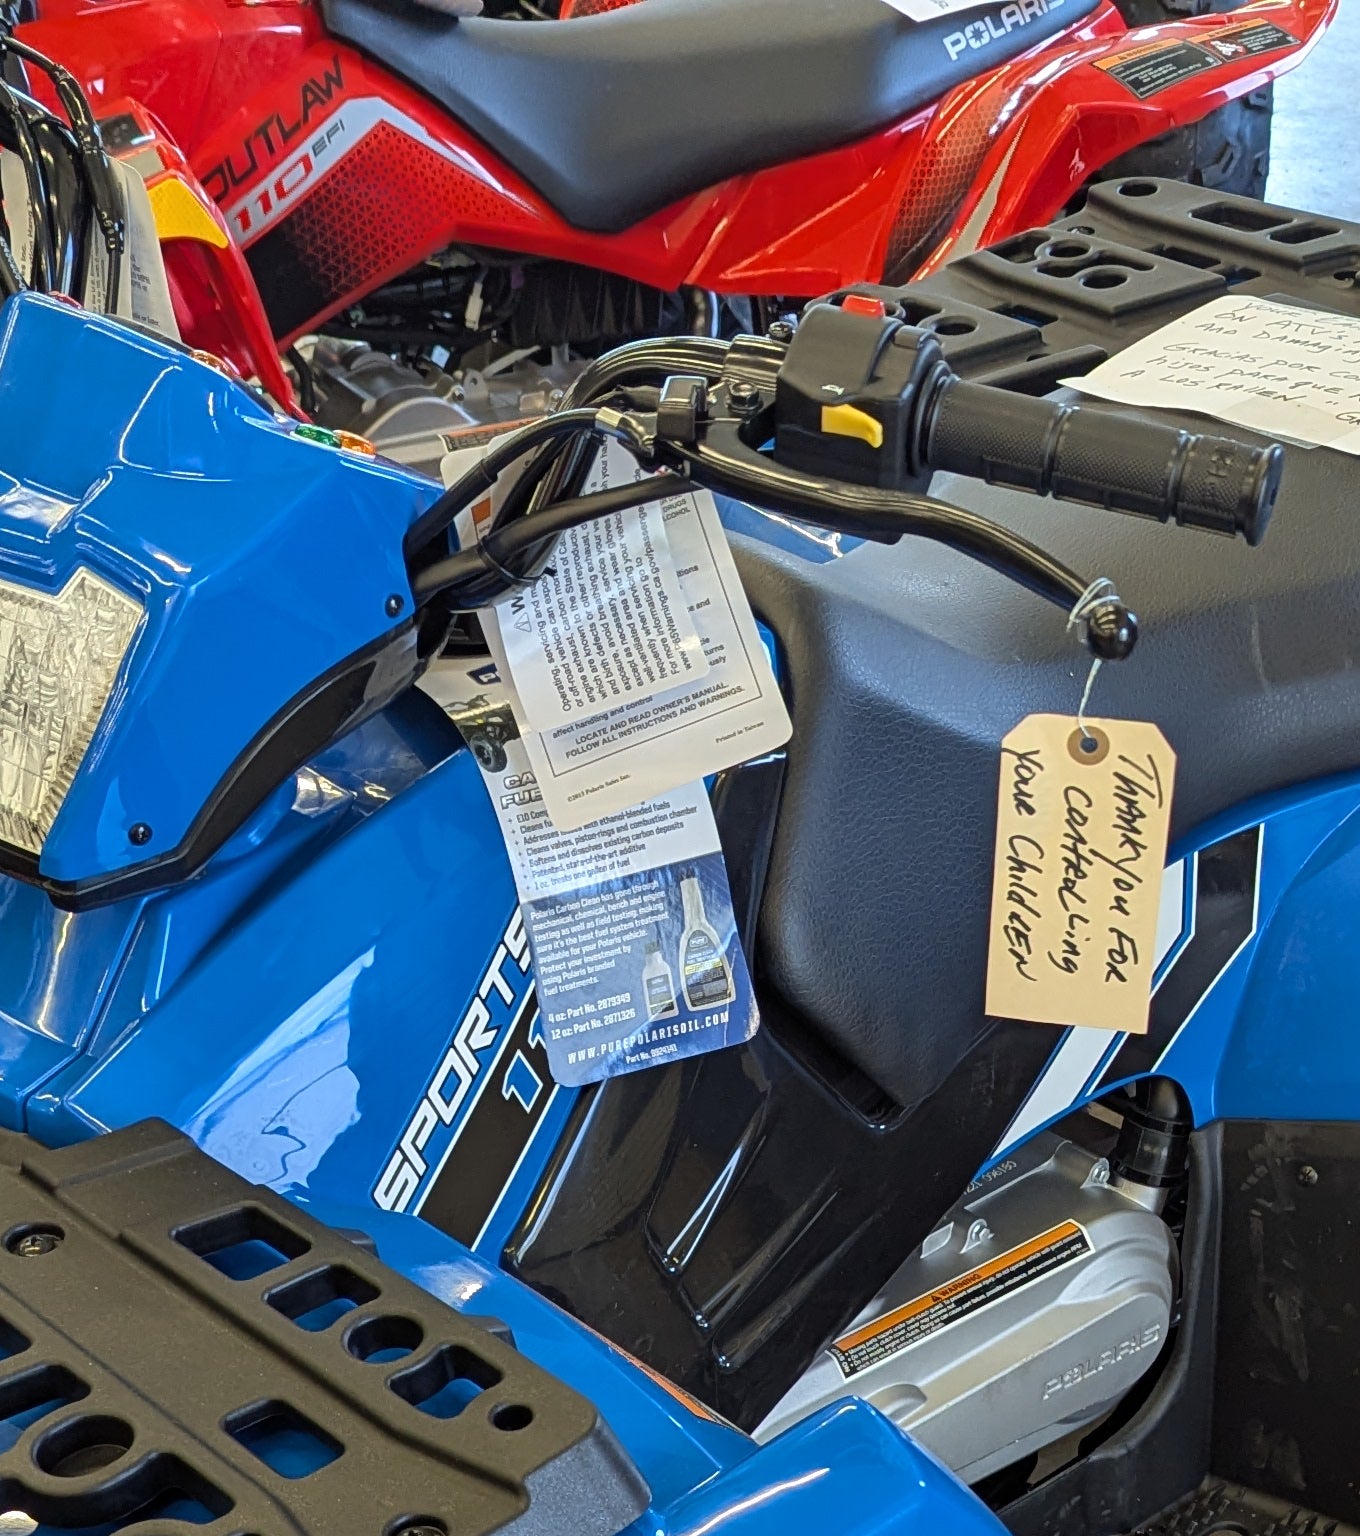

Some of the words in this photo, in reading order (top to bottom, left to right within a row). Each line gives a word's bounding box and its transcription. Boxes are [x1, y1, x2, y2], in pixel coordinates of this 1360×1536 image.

[200, 54, 344, 204] OUTLAW
[236, 153, 314, 232] 110
[311, 118, 345, 157] EFI
[591, 533, 606, 555] your
[598, 517, 619, 549] gloves
[558, 555, 569, 566] of
[576, 531, 600, 572] exhaust,
[606, 550, 621, 575] wear
[617, 542, 632, 564] your
[632, 556, 643, 567] to
[559, 567, 576, 594] State
[594, 557, 614, 592] service
[611, 577, 626, 597] and
[622, 565, 645, 609] servicing
[637, 568, 648, 582] go
[566, 595, 579, 612] the
[575, 582, 592, 608] other
[586, 573, 610, 620] breathing
[529, 599, 543, 619] and
[544, 606, 557, 625] can
[554, 597, 572, 631] carbon
[571, 613, 582, 623] to
[583, 609, 593, 621] or
[619, 598, 633, 621] area
[640, 583, 665, 636] information
[599, 621, 616, 648] avoid
[635, 610, 652, 637] when
[534, 620, 557, 664] servicing
[549, 625, 568, 661] vehicle
[575, 624, 592, 657] known
[587, 621, 605, 657] defects
[622, 646, 632, 658] as
[626, 620, 656, 683] well-ventilated
[659, 636, 674, 659] more
[586, 657, 598, 673] are
[599, 657, 613, 678] birth
[610, 647, 634, 690] exposure,
[644, 636, 669, 680] frequently
[667, 659, 680, 675] For
[561, 661, 580, 697] off-road
[592, 673, 608, 698] which
[607, 678, 620, 694] and
[627, 658, 645, 687] except
[548, 664, 573, 712] Operating,
[579, 673, 597, 702] engine
[573, 697, 583, 707] or
[551, 723, 574, 739] affect
[574, 711, 609, 731] handling
[609, 706, 624, 717] and
[624, 694, 654, 711] control
[564, 739, 601, 759] FOLLOW
[600, 732, 618, 745] ALL
[617, 709, 678, 738] INSTRUCTIONS
[677, 701, 697, 715] AND
[574, 726, 608, 745] LOCATE
[607, 718, 628, 732] AND
[626, 709, 652, 724] READ
[500, 786, 542, 811] FUE
[547, 1014, 554, 1023] 4
[566, 1005, 583, 1018] Part
[583, 1001, 597, 1013] No.
[549, 1028, 561, 1040] 12
[571, 1020, 590, 1033] Part
[589, 1016, 603, 1028] No.
[566, 1009, 730, 1066] WWW.PUREPOLARISOIL.COM
[940, 1272, 982, 1299] WARNING
[1042, 1323, 1161, 1401] POLARIS
